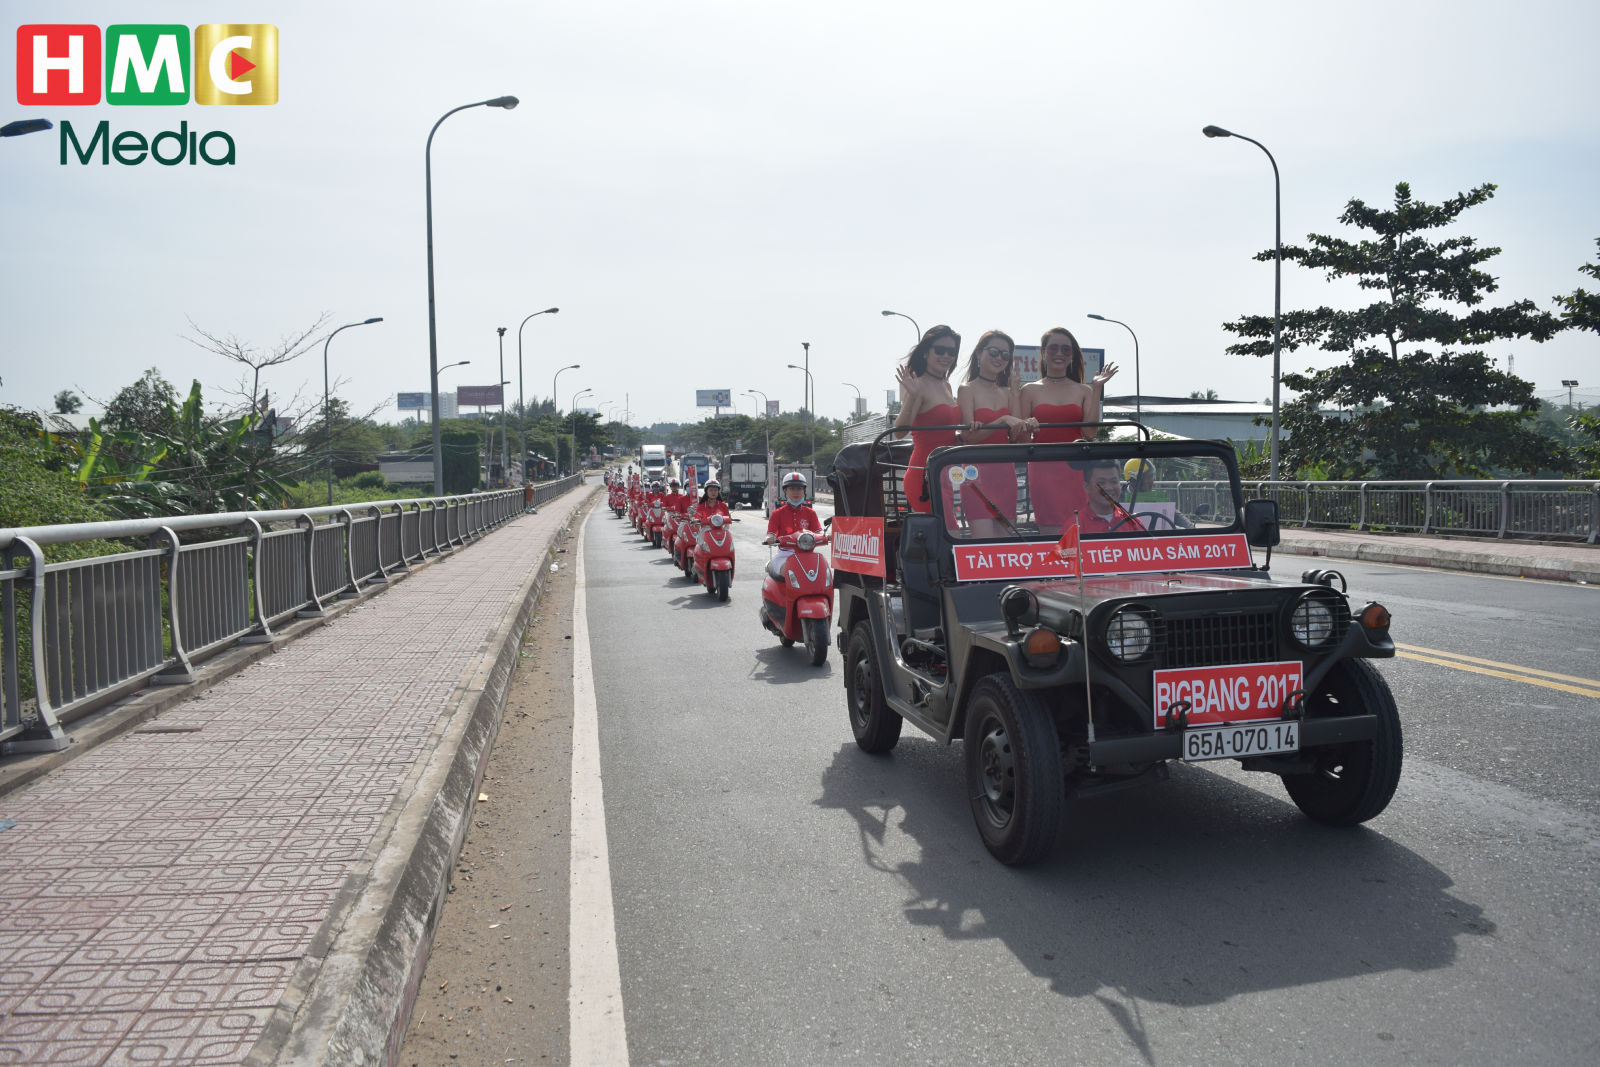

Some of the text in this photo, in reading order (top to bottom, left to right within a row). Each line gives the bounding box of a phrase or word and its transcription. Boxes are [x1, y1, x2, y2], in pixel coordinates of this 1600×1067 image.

[966, 551, 994, 569] TÀI
[997, 552, 1033, 570] TRỢ
[1087, 546, 1123, 563] TIẾP
[1127, 547, 1164, 562] MUA
[1166, 543, 1201, 560] SẮM
[1204, 543, 1237, 558] 2017
[1157, 673, 1300, 717] BIGBANG 2017
[1188, 725, 1295, 757] 65A-070.14
